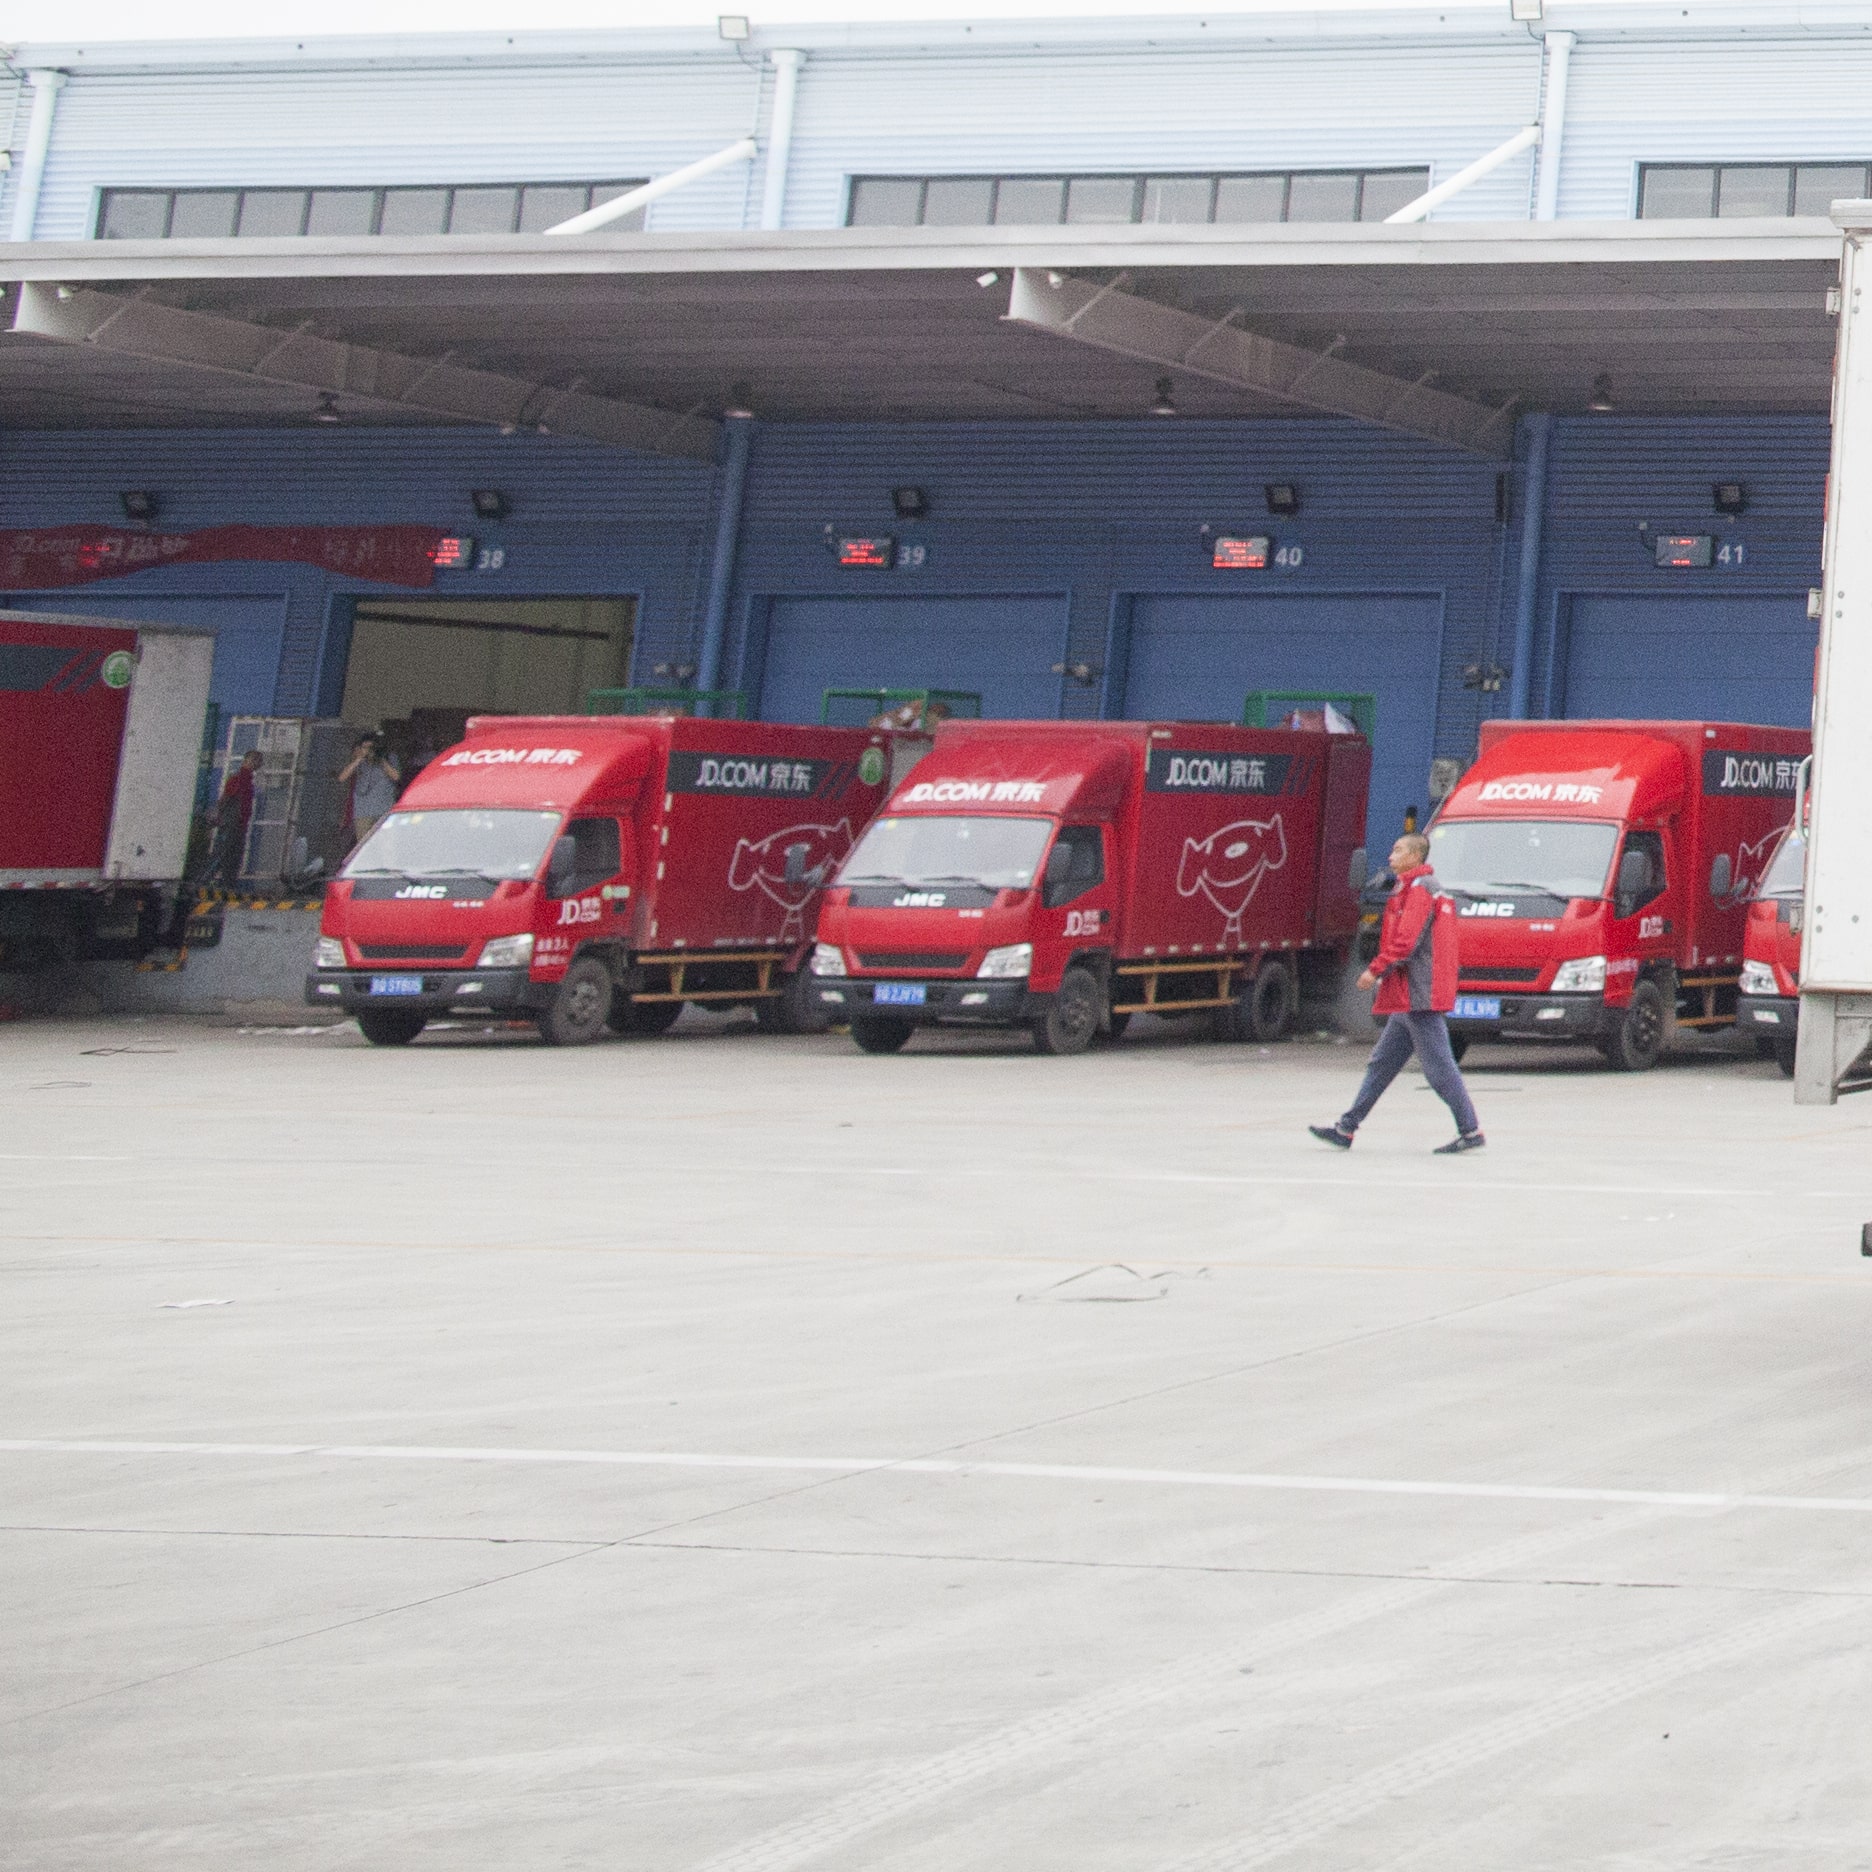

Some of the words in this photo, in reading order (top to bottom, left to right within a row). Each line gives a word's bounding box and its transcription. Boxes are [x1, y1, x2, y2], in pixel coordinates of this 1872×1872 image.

[478, 549, 504, 569] 38
[898, 545, 926, 565] 39
[1274, 546, 1302, 566] 40
[1717, 544, 1744, 564] 41
[696, 759, 768, 789] JD.COM
[769, 762, 812, 791] 京东
[1165, 757, 1227, 786] JD.COM
[1230, 760, 1266, 788] 京东
[1721, 756, 1773, 788] JD.COM
[903, 782, 990, 802] JD.COM
[990, 781, 1047, 802] 京东
[1478, 783, 1553, 802] JD.COM
[1553, 783, 1604, 803] 京东
[395, 886, 447, 899] JMC
[893, 893, 946, 907] JMC
[1461, 902, 1515, 917] JMC
